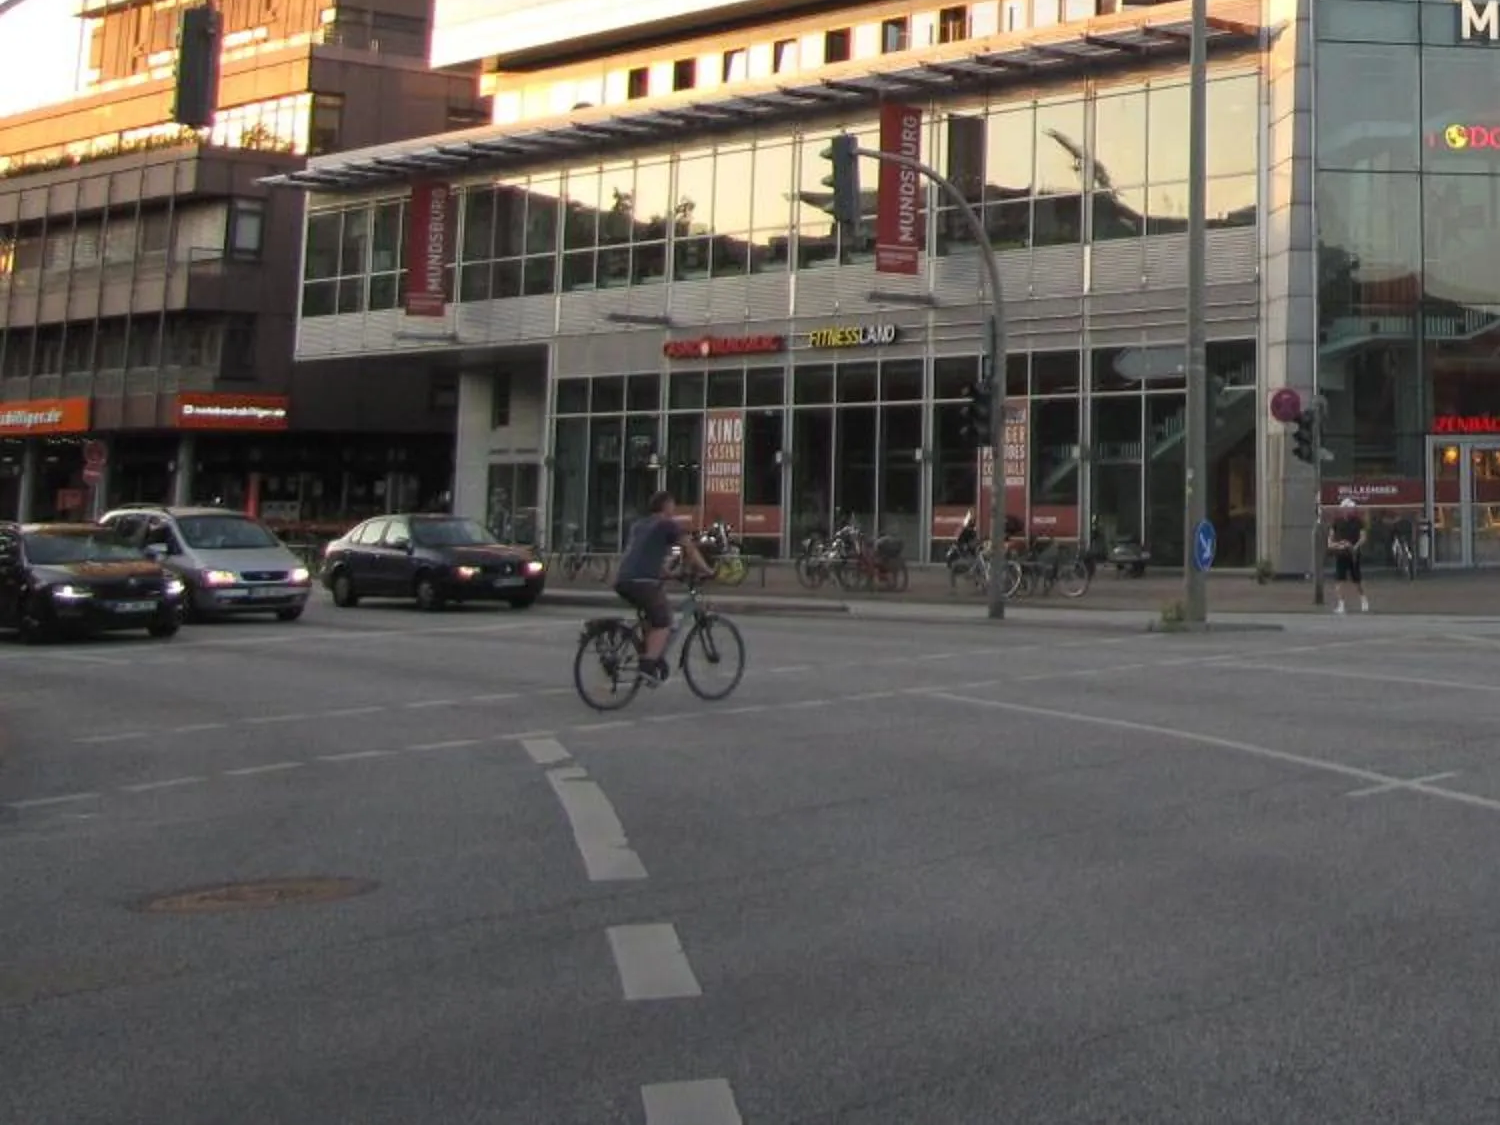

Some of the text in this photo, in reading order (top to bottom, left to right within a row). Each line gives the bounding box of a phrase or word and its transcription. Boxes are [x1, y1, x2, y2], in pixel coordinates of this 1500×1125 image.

[899, 115, 918, 242] MUNDSURG
[808, 324, 896, 348] FITNESSLAND
[707, 418, 743, 443] KINO
